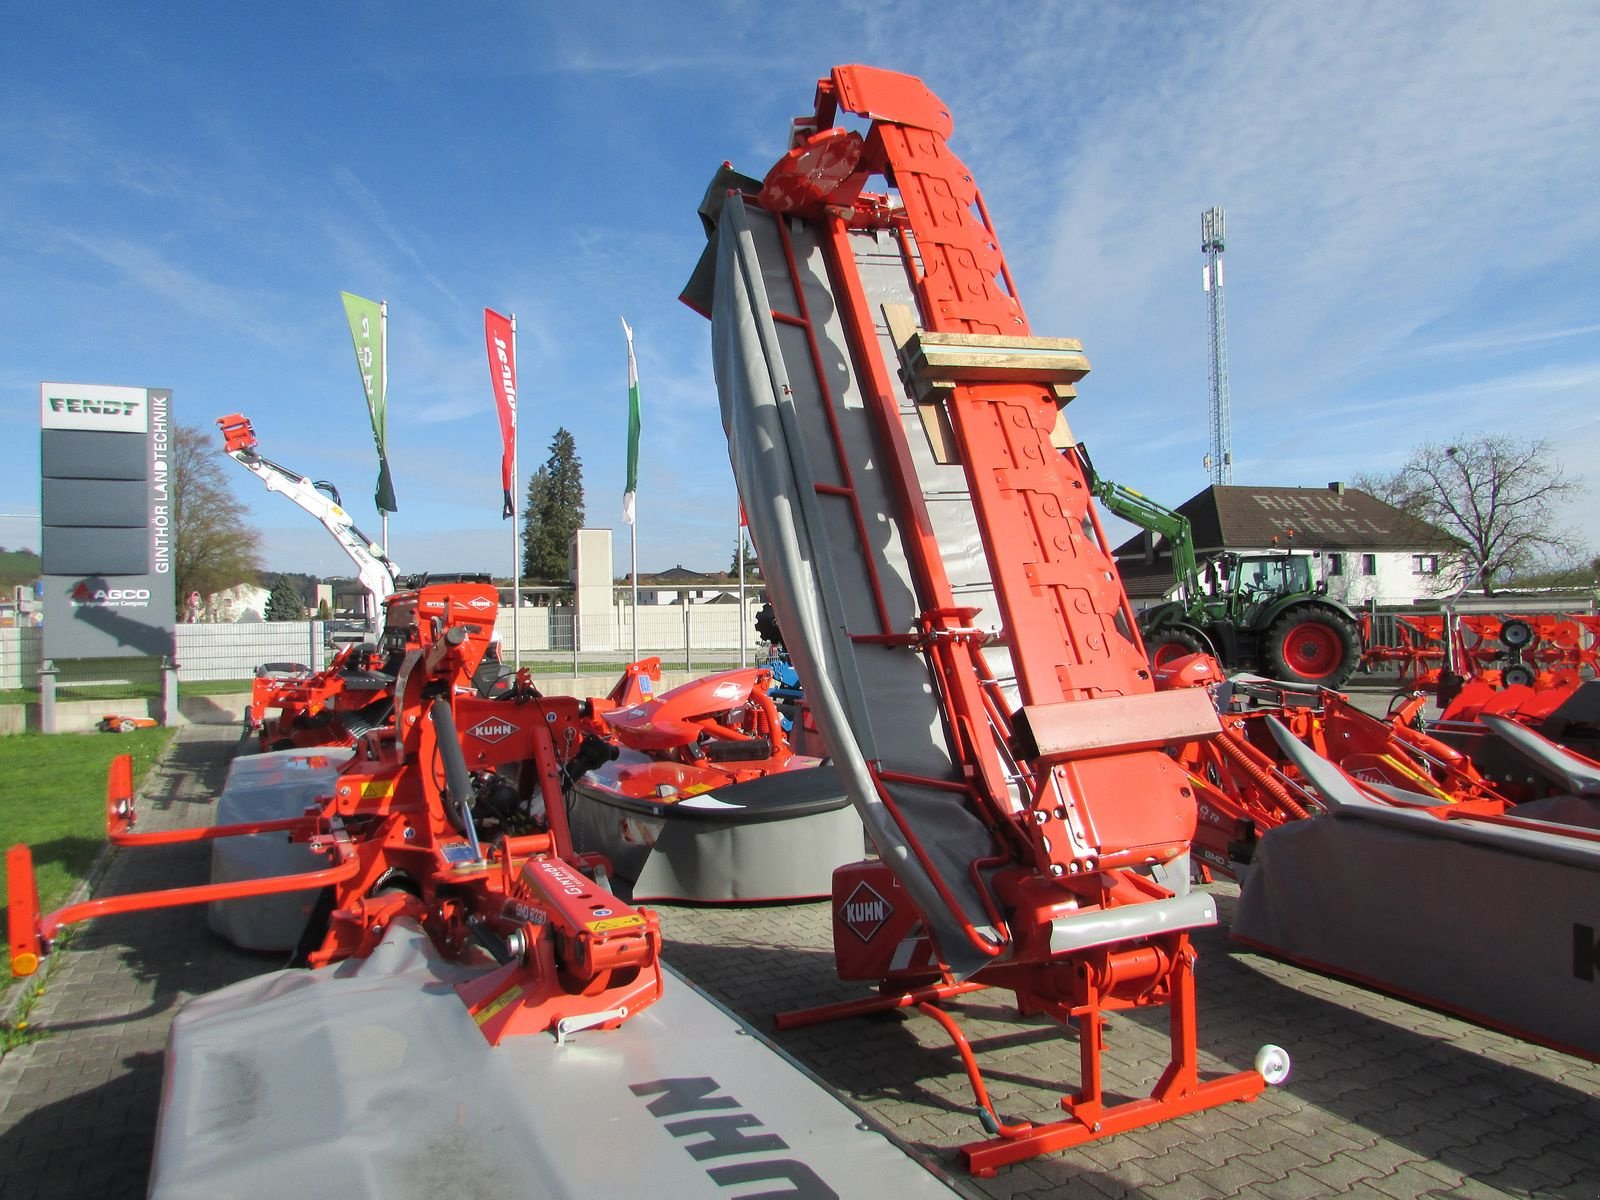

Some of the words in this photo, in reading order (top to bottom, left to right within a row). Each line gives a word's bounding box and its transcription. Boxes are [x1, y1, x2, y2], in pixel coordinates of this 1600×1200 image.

[49, 398, 139, 416] FENDT
[153, 397, 168, 500] LANDTECHNIK
[151, 505, 169, 574] GINTHÖR
[95, 589, 150, 599] AGCO
[475, 725, 512, 736] KUHN
[1205, 850, 1225, 865] GMD
[846, 900, 884, 922] KUHN
[628, 1076, 840, 1200] UHN
